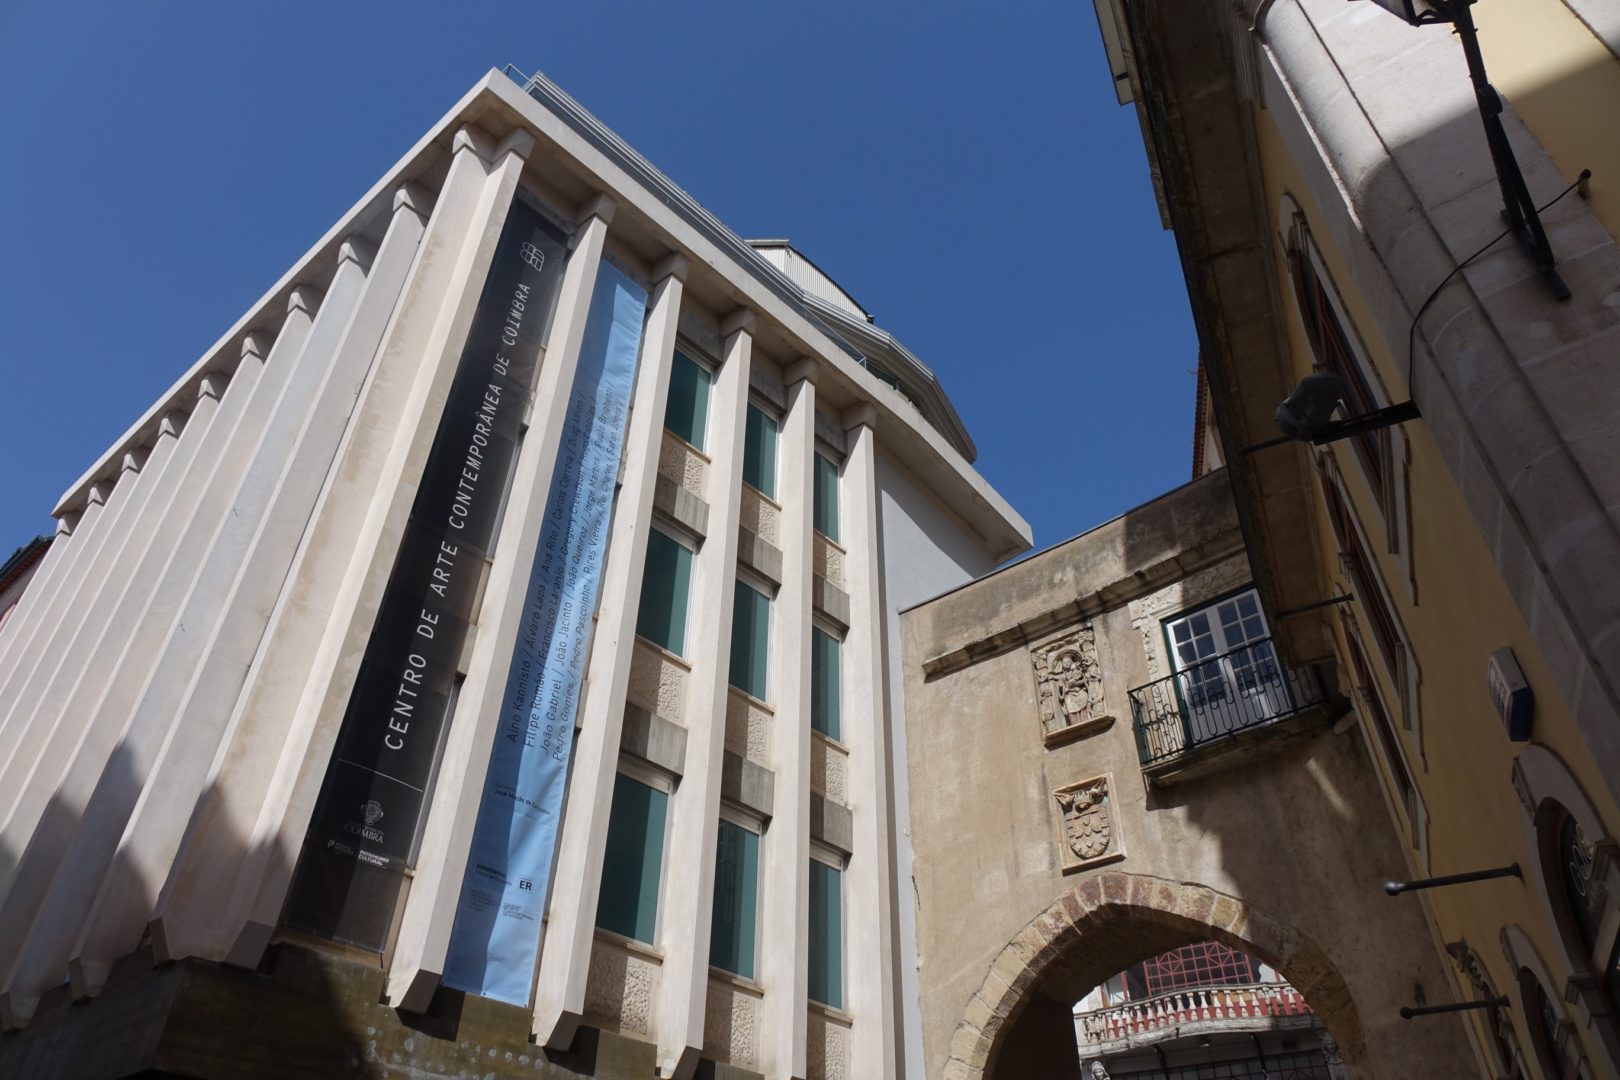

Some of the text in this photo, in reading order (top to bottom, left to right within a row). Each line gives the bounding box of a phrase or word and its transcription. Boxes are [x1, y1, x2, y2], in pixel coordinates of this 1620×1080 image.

[589, 457, 601, 487] Martins
[384, 283, 530, 750] CENTRO DE ARTE CONTEMPORÂNEA DE COIMBRA
[554, 490, 566, 520] Carlos
[584, 490, 597, 517] Jorge
[547, 530, 558, 550] Rito
[561, 516, 577, 557] Gregory
[573, 526, 588, 565] Queiroz
[589, 519, 601, 548] Vieira
[542, 554, 553, 573] Ana
[567, 566, 578, 590] João
[584, 550, 595, 575] Pires
[535, 585, 548, 610] Lapa
[550, 567, 566, 606] Laranjo
[558, 601, 574, 638] Jacinto
[575, 585, 591, 635] Pascoinho
[539, 609, 557, 659] Francisco
[555, 641, 568, 666] João
[571, 638, 582, 669] Pedro
[513, 661, 532, 711] Kannisto
[530, 672, 546, 709] Romão
[546, 679, 562, 720] Gabriel
[561, 683, 574, 721] Gomes
[507, 714, 522, 742] Aino
[524, 714, 541, 749] Filipe
[541, 725, 553, 754] João
[553, 725, 567, 761] Pedro
[519, 880, 533, 891] ER
